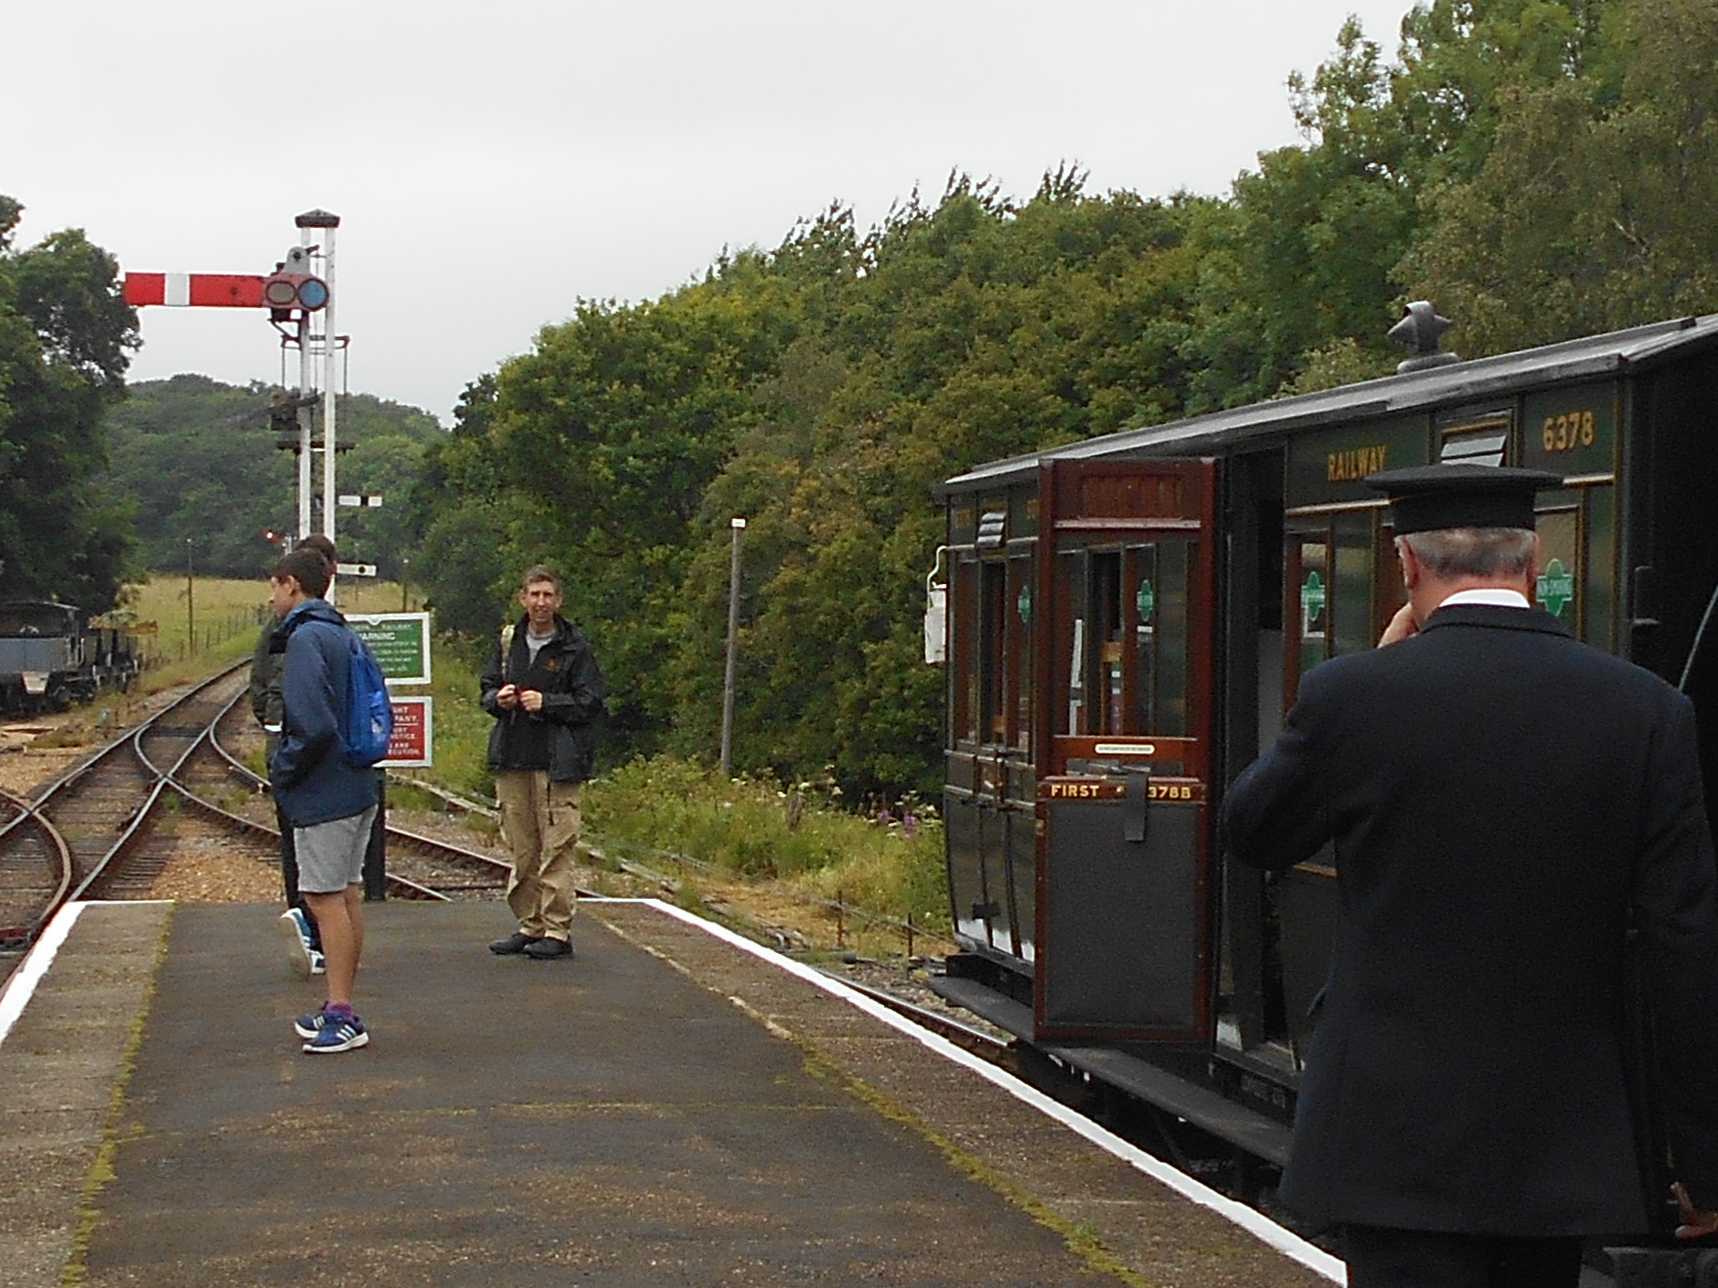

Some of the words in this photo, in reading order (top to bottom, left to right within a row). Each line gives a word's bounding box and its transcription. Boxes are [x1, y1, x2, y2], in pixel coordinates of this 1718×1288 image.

[1327, 443, 1387, 482] RAILWAY
[1543, 411, 1594, 451] 6378
[1051, 784, 1100, 798] FIRST
[1147, 786, 1192, 800] 378B
